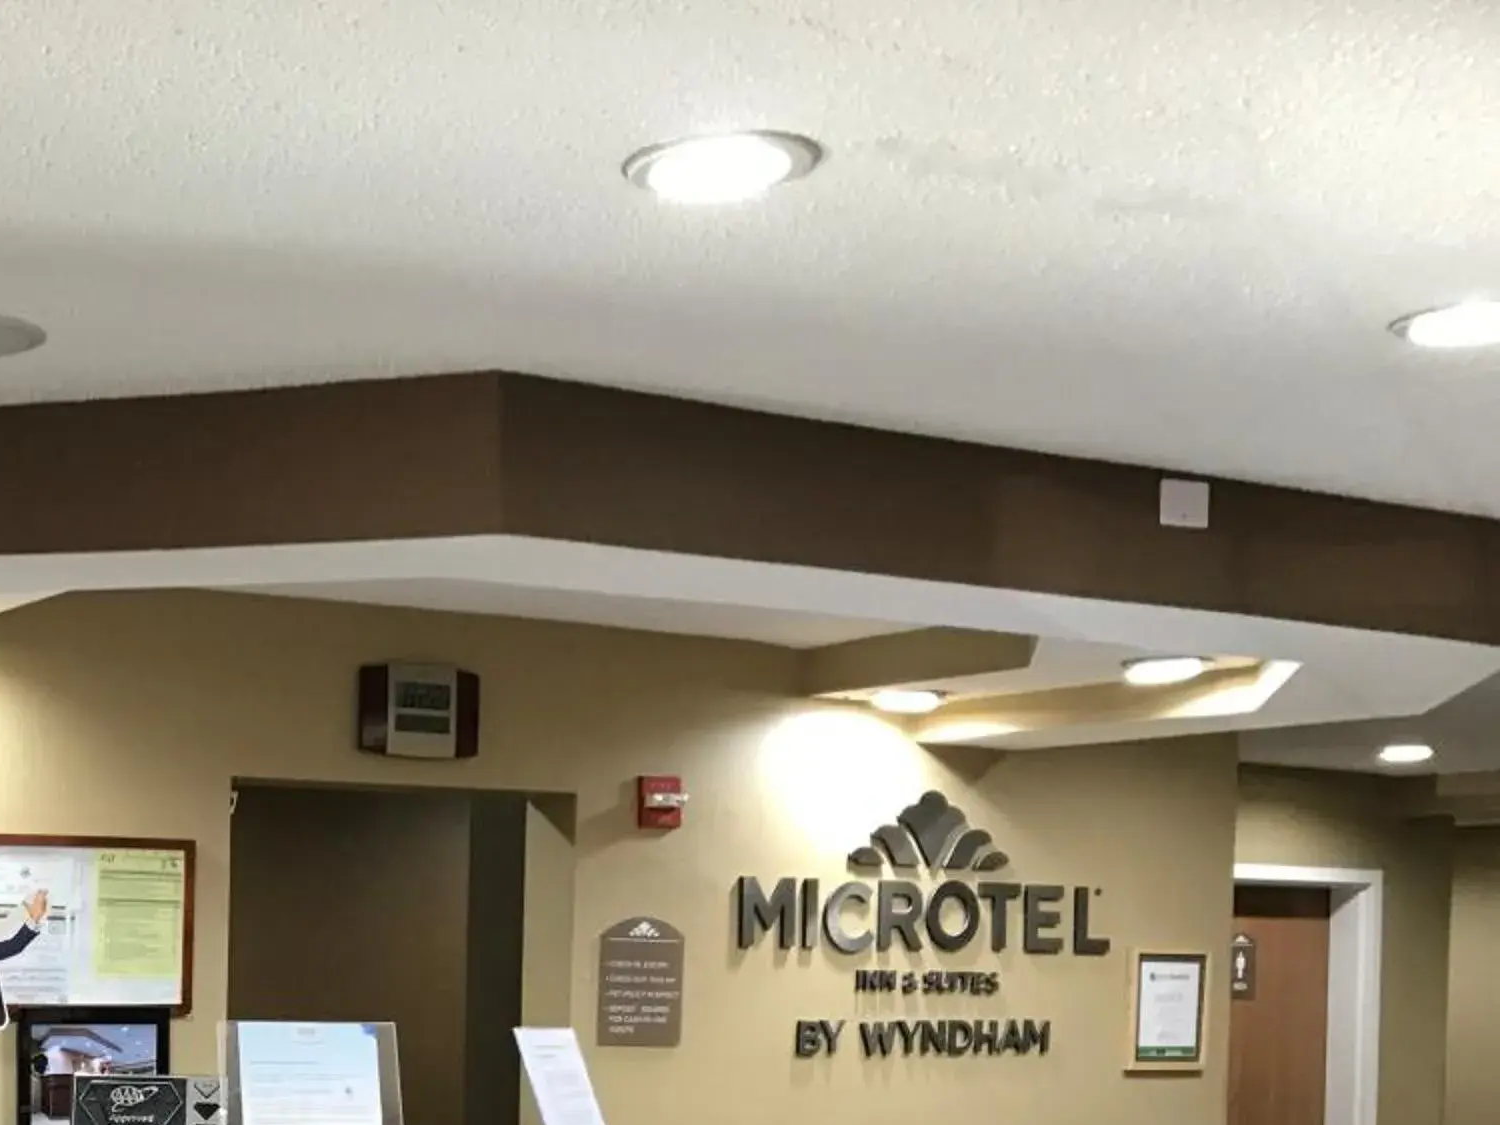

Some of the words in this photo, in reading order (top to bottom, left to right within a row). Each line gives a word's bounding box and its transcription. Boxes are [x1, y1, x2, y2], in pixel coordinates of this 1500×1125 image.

[738, 876, 1111, 955] MICROTEL
[854, 969, 897, 993] INN
[921, 971, 999, 996] SUITES
[795, 1020, 846, 1058] BY
[859, 1019, 1051, 1058] WYNDHAM
